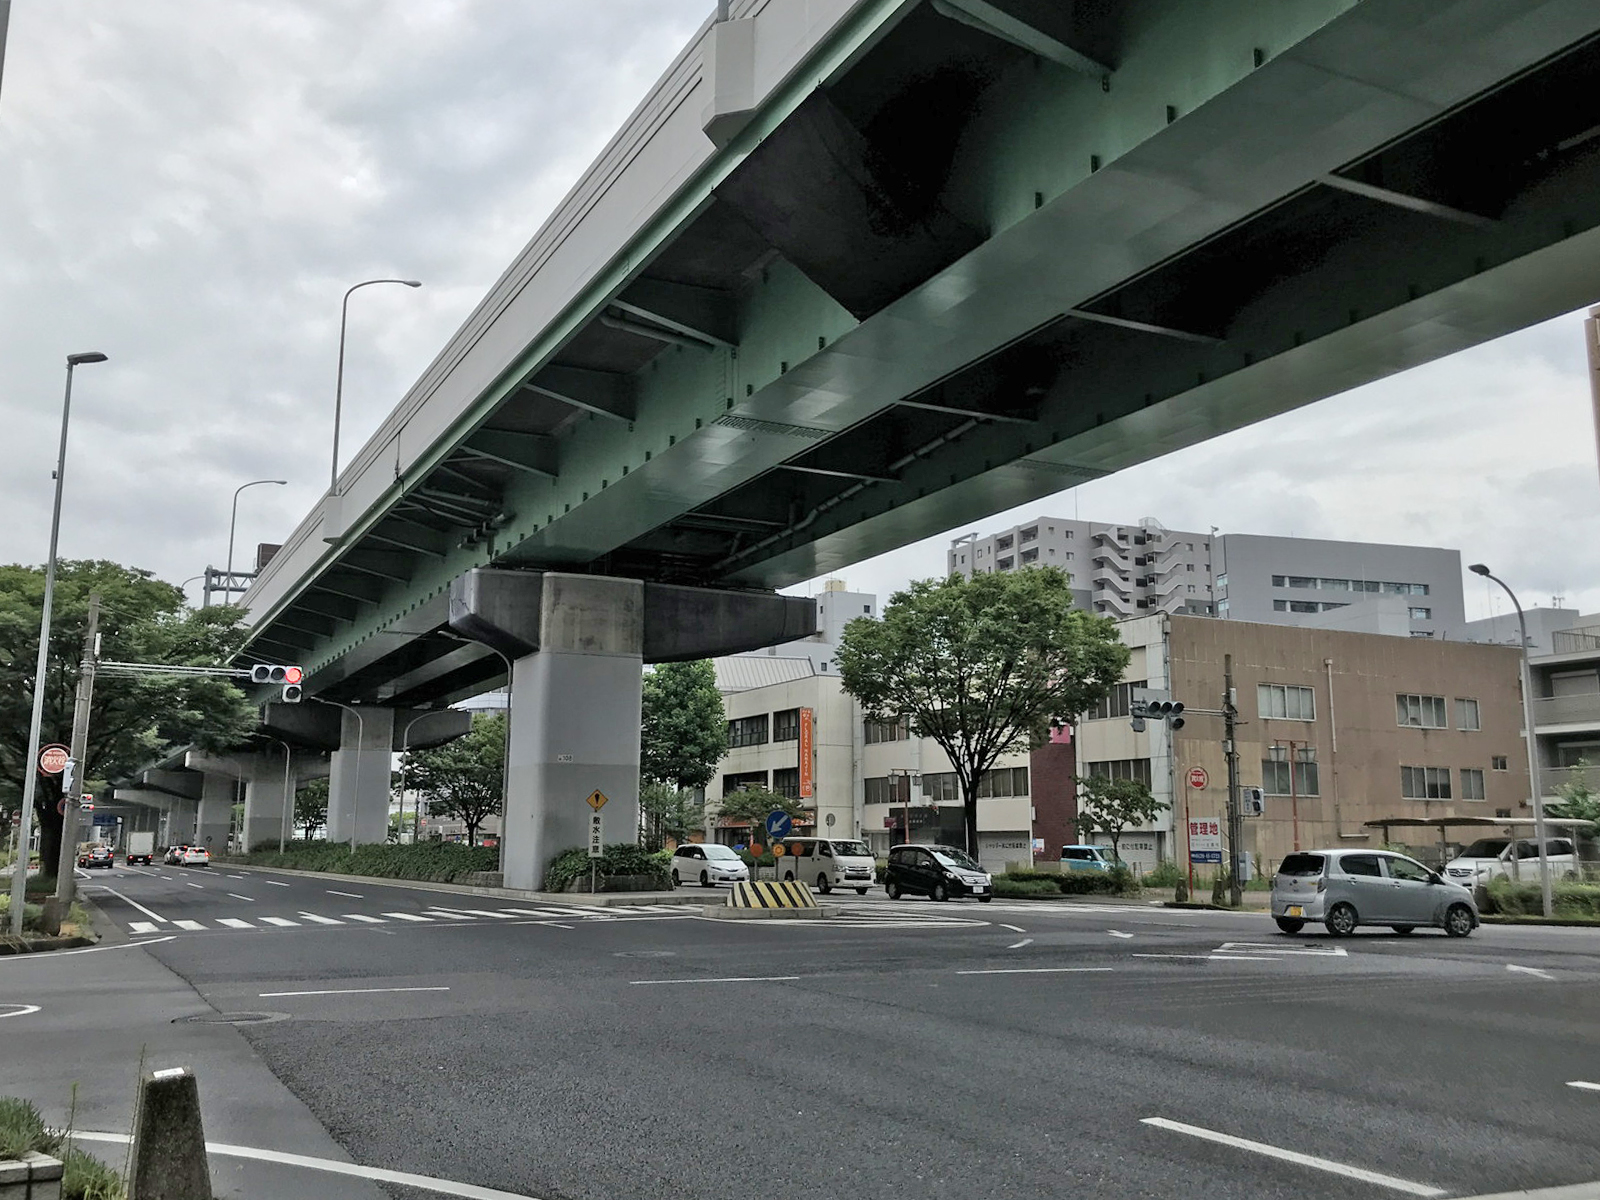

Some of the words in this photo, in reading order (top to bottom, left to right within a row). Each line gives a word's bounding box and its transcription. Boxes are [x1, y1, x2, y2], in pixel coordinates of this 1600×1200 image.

[592, 816, 601, 853] 散水注意
[1190, 821, 1218, 836] 管理地
